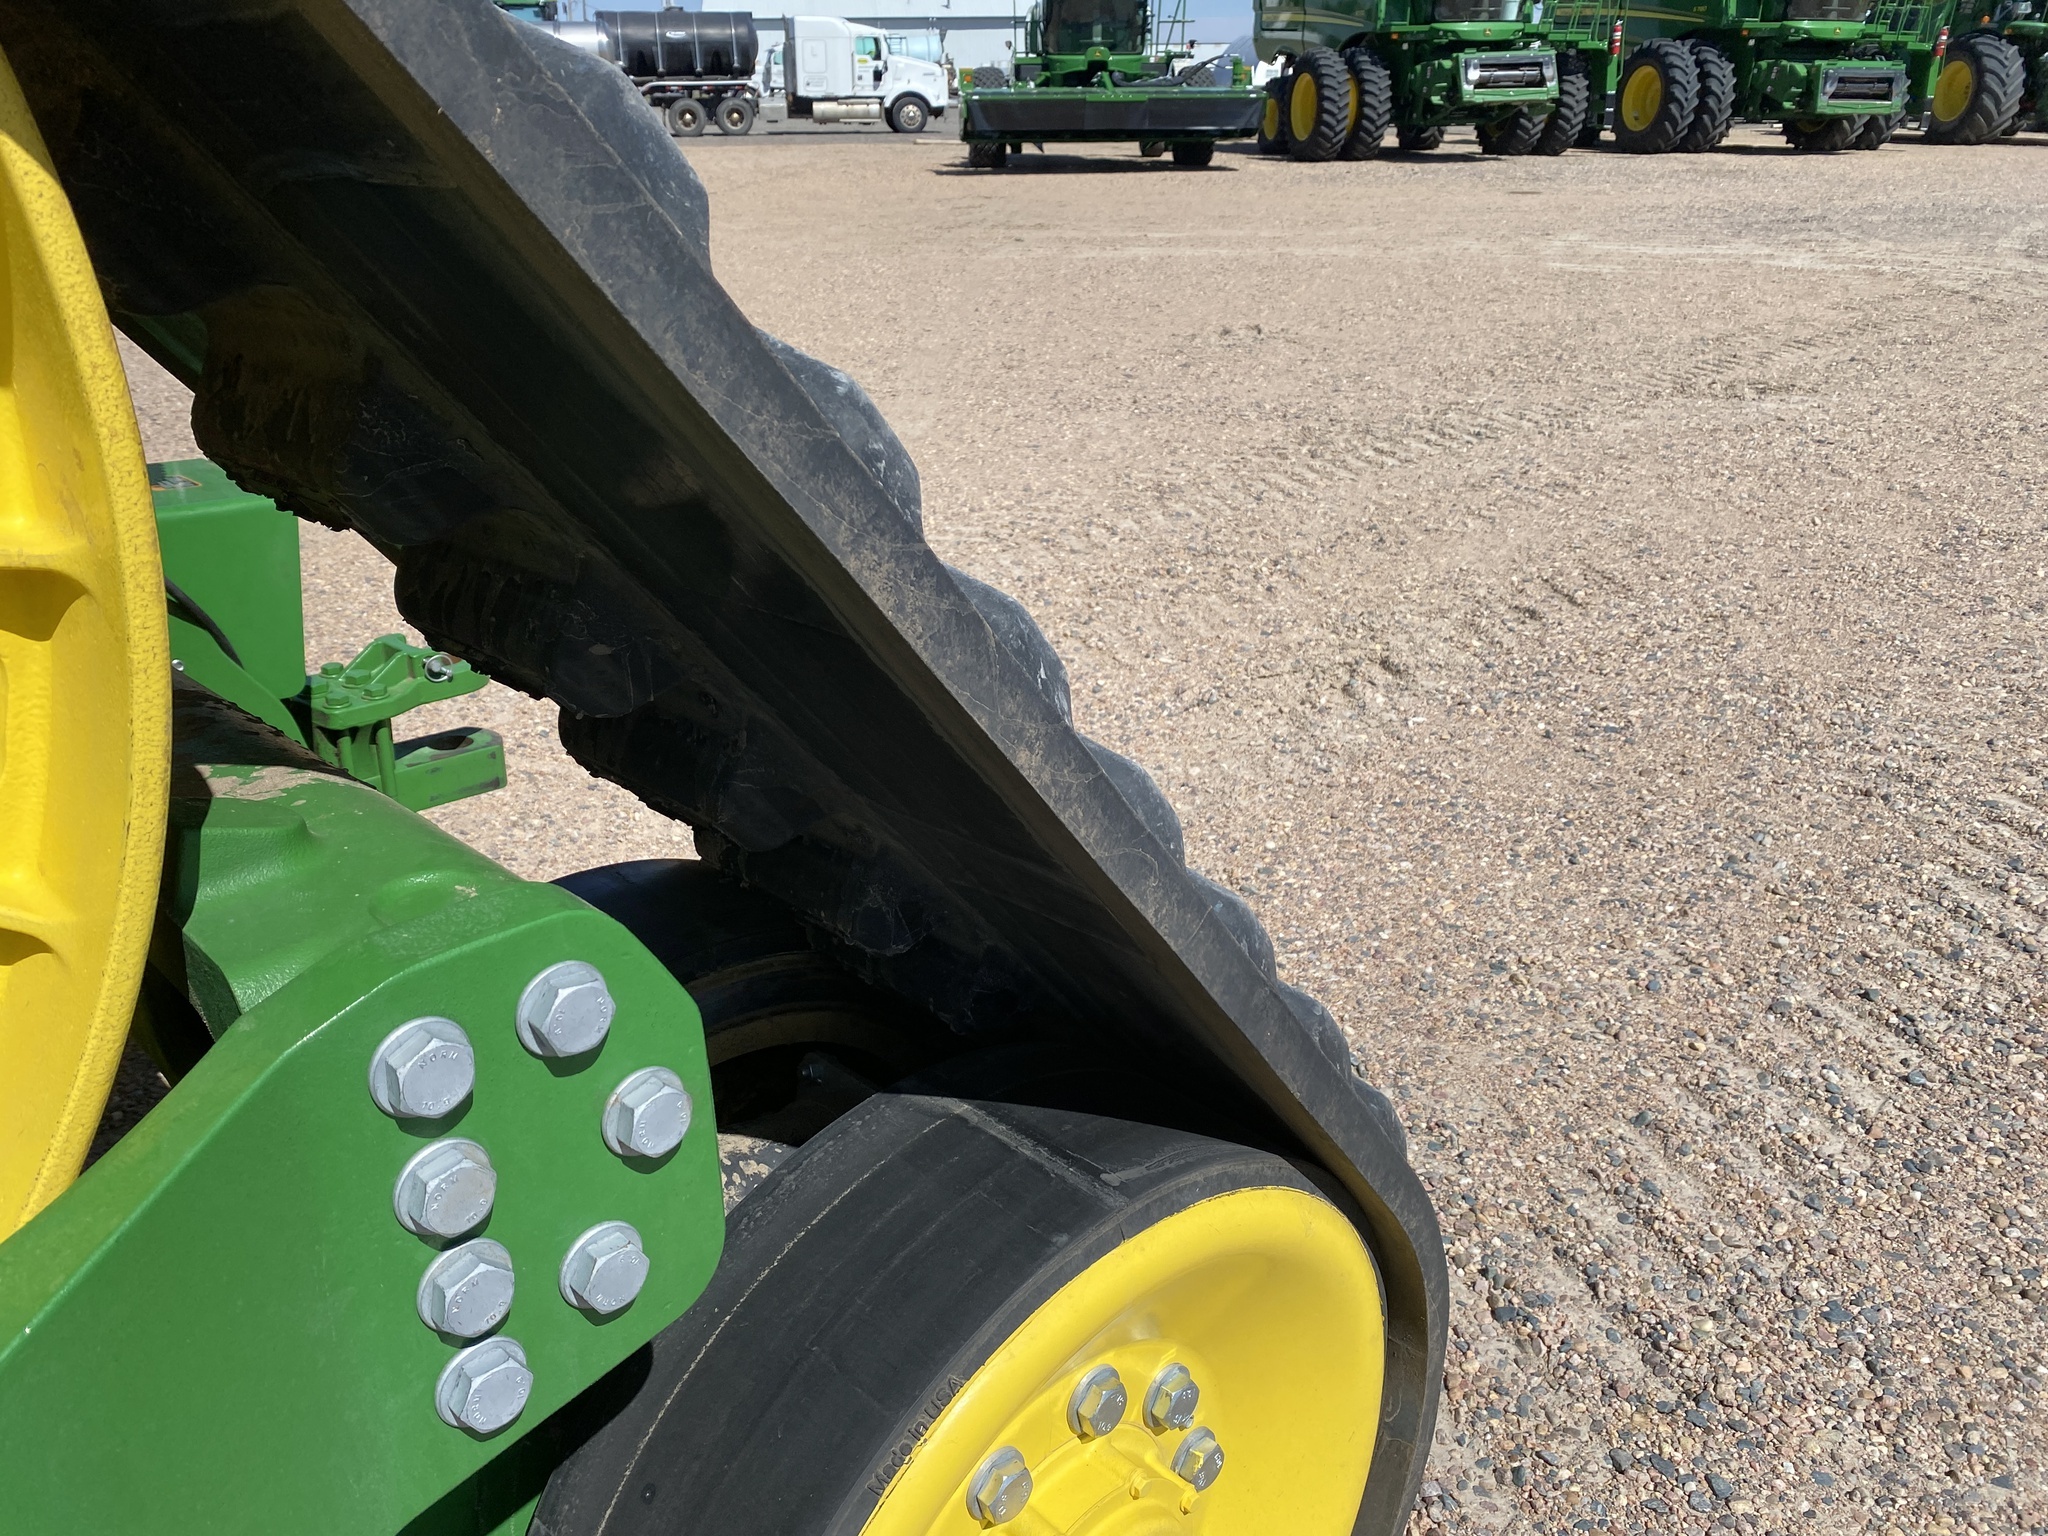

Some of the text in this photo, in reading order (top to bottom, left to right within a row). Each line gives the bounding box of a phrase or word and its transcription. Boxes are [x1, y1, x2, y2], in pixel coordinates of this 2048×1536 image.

[417, 1050, 459, 1070] NORM
[430, 1174, 459, 1211] NORM
[924, 1374, 966, 1420] USA
